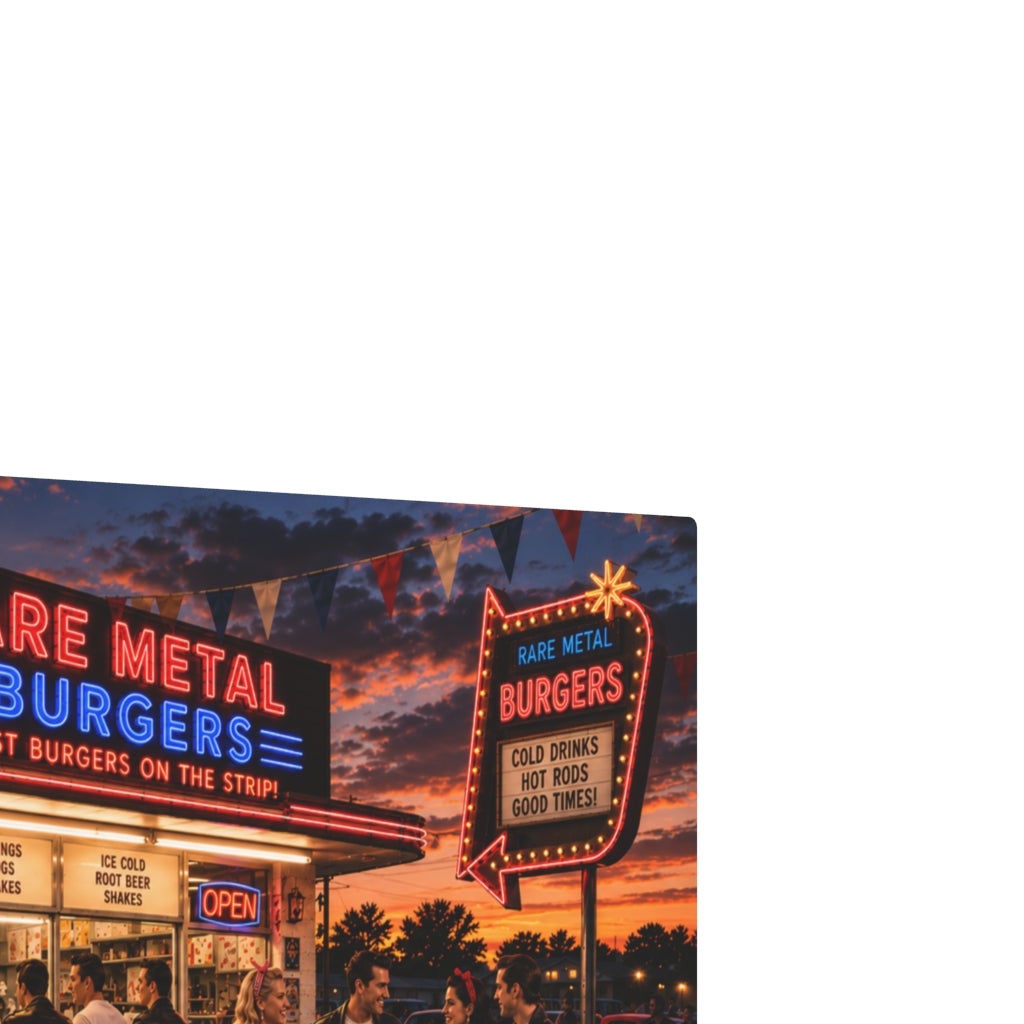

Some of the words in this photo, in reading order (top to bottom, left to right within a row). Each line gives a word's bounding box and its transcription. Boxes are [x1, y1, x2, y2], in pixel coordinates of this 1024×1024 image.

[517, 638, 556, 666] RARE
[562, 626, 613, 656] METAL
[113, 620, 286, 716] METAL
[499, 661, 624, 723] BURGERS
[30, 736, 130, 777] BURGERS
[140, 756, 169, 782] ON
[179, 764, 215, 791] THE
[223, 771, 279, 799] STRIP!
[511, 744, 545, 769] COLD
[550, 735, 599, 762] DRINKS
[521, 768, 547, 792] HOT
[553, 762, 589, 786] RODS
[512, 794, 548, 818] GOOD
[553, 787, 598, 811] TIMES!
[101, 854, 117, 869] ICE
[120, 856, 146, 872] COLD
[95, 871, 122, 888] ROOT
[125, 874, 151, 890] BEER
[104, 889, 143, 907] SHAKES
[202, 889, 257, 920] OPEN
